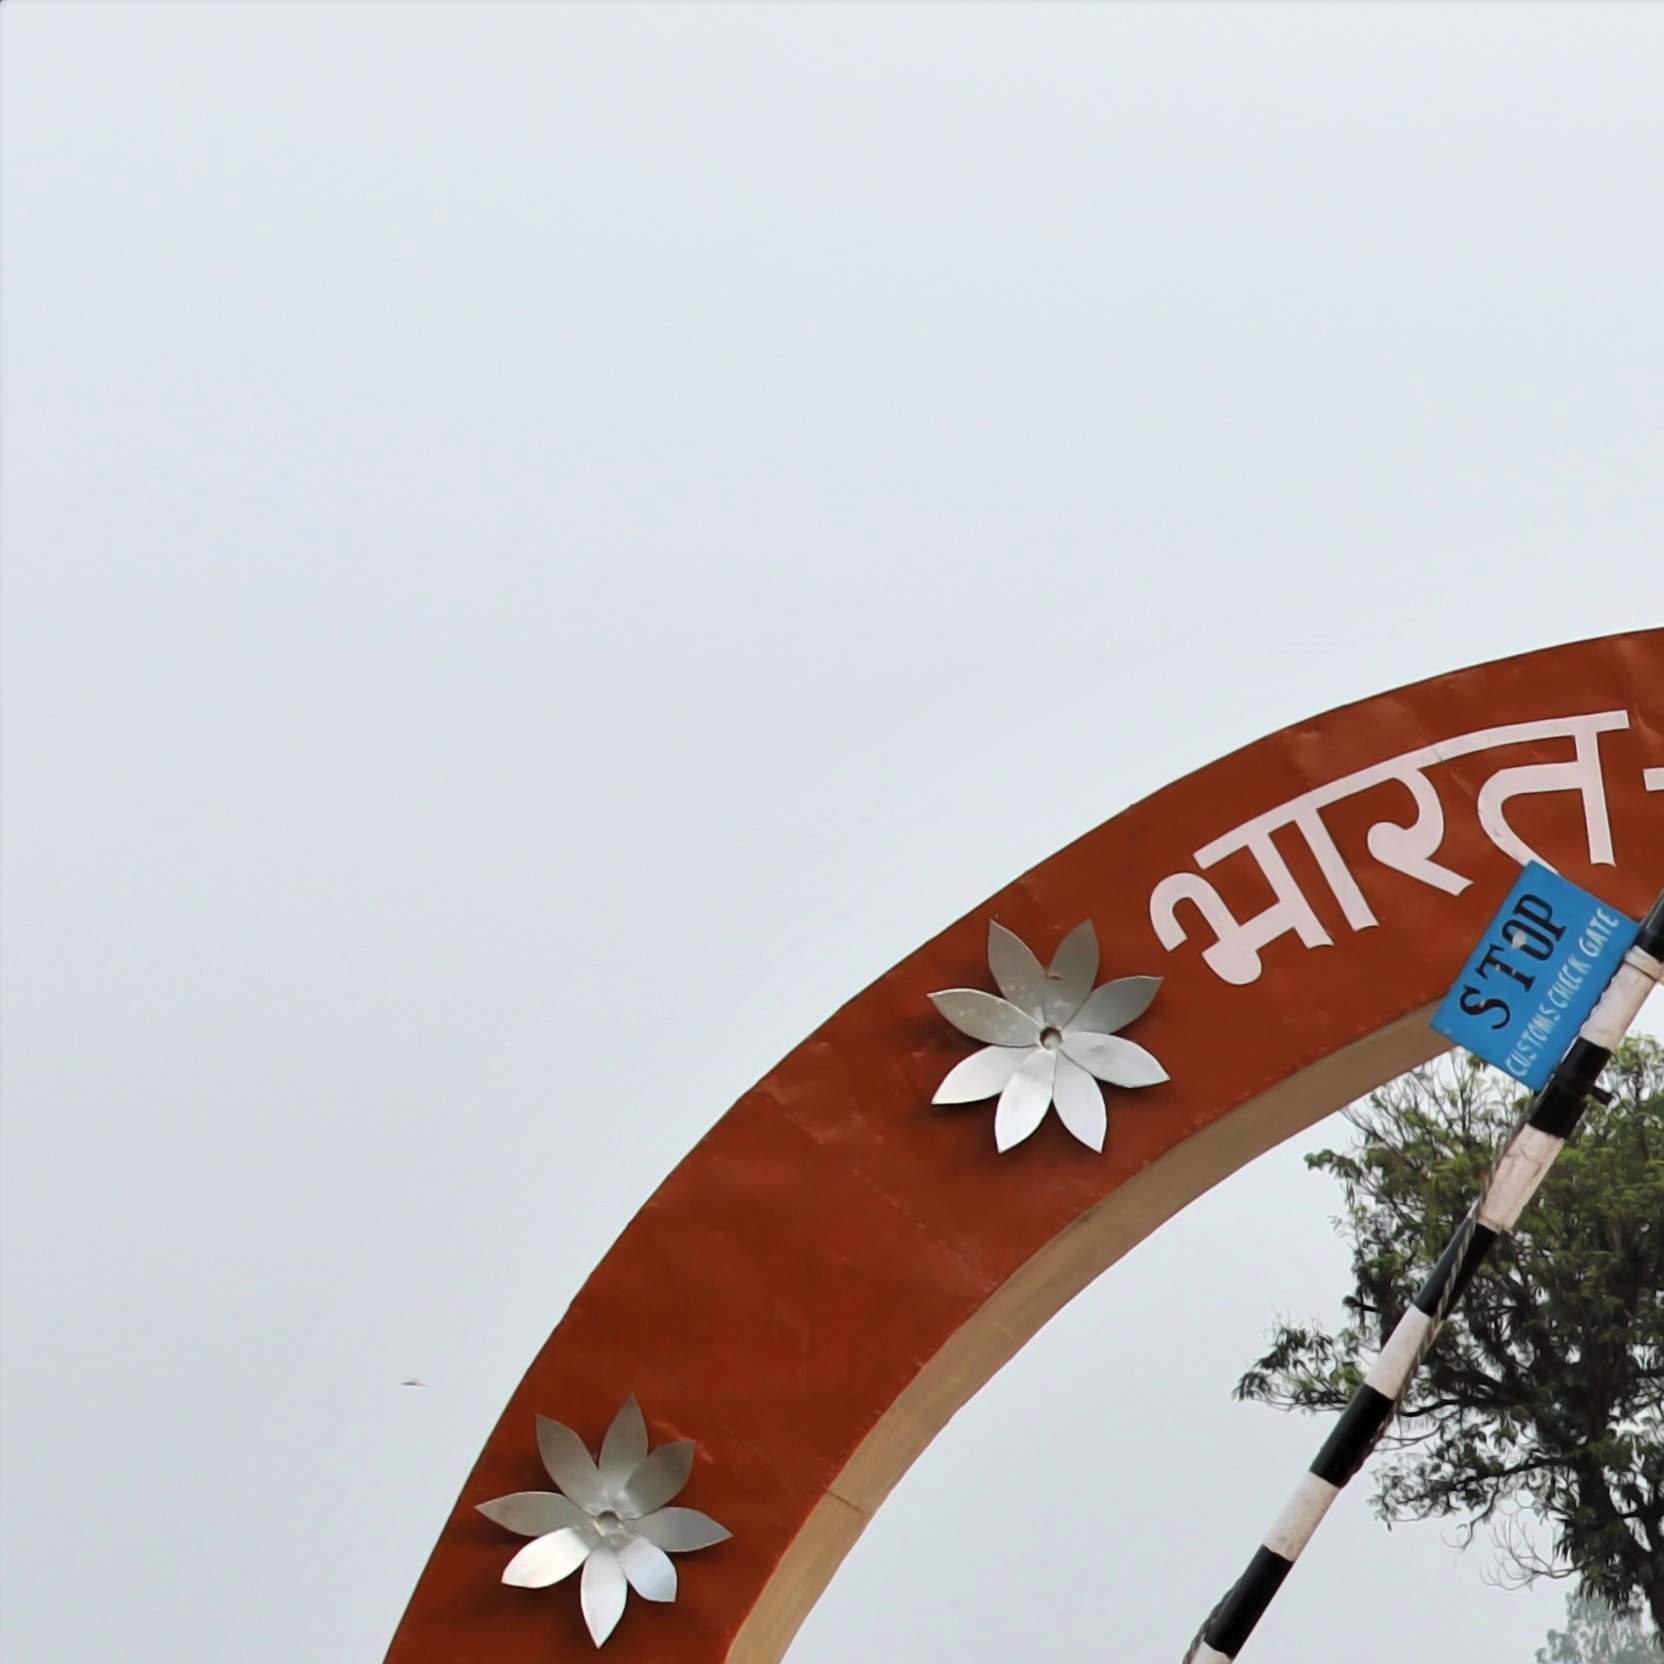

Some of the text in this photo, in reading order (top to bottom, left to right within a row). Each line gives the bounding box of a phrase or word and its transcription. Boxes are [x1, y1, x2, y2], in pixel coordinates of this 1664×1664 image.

[1460, 894, 1566, 1030] STOP
[1505, 908, 1619, 1077] CUSTOMS CHECK GATE
